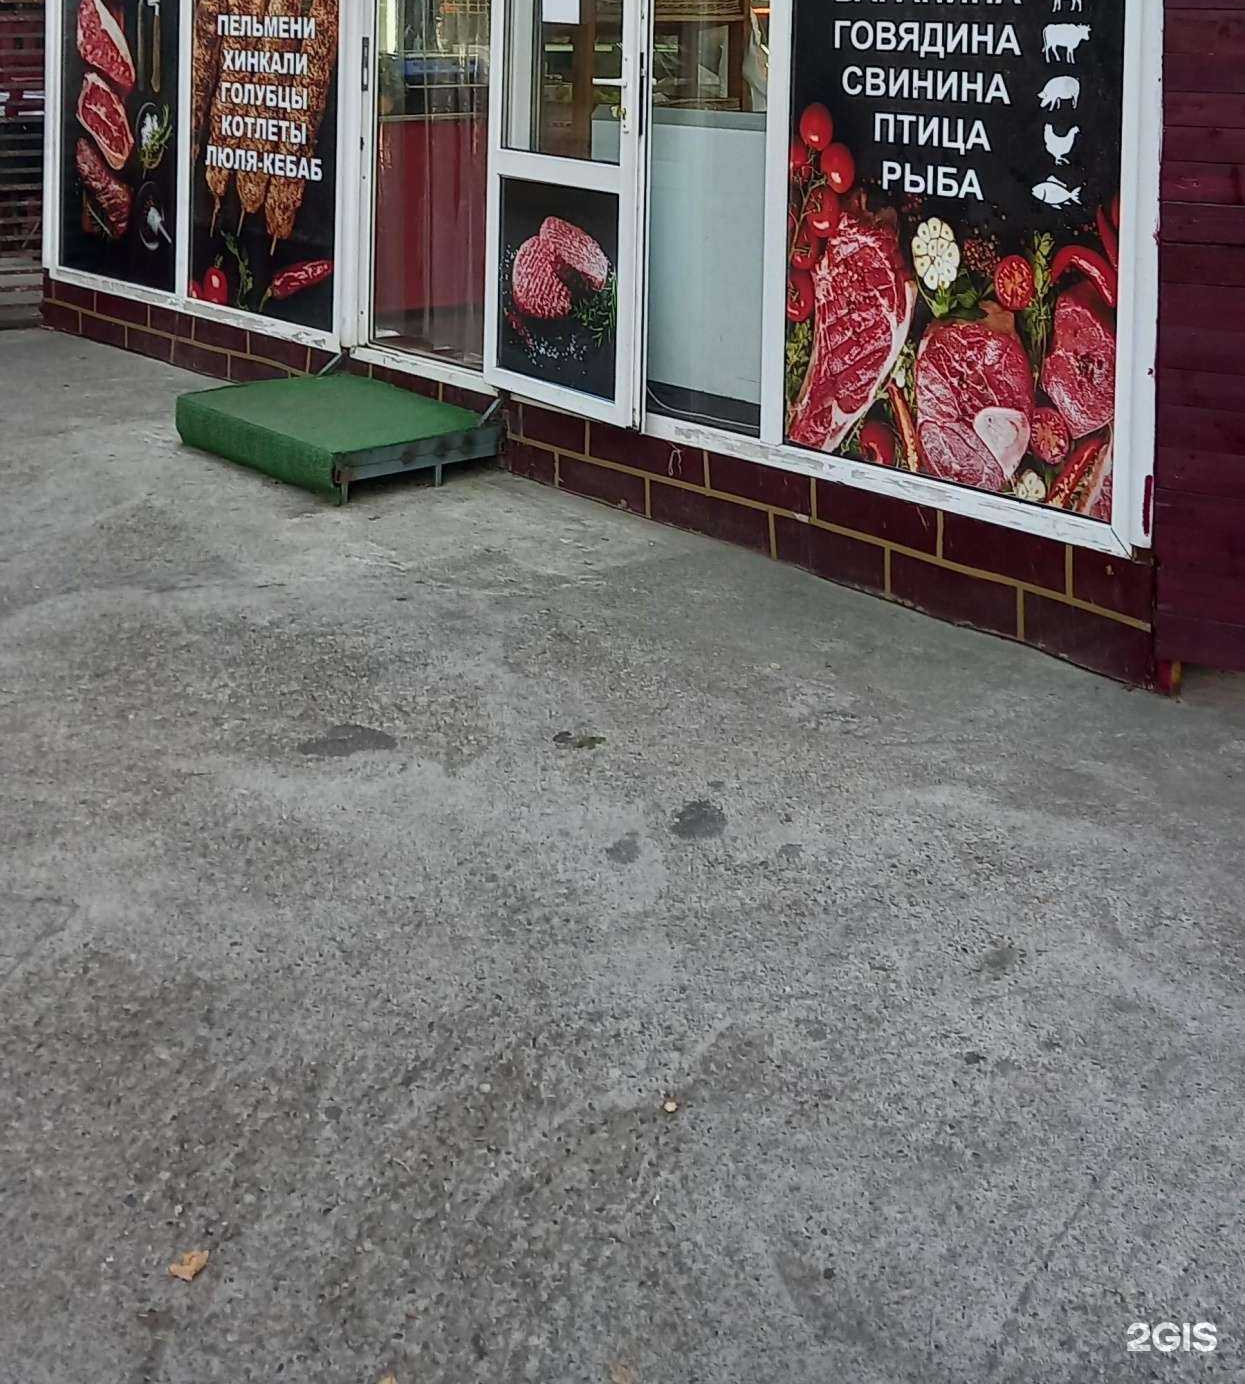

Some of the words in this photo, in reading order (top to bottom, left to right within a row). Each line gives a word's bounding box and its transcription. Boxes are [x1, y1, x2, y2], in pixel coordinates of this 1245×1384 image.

[217, 13, 316, 41] ПЕЛЬМЕНИ
[833, 20, 1022, 58] ГОВЯДИНА
[223, 49, 308, 76] ХИНКАЛИ
[220, 81, 308, 113] ГОЛУБЦЫ
[841, 65, 1011, 105] СВИНИНА
[221, 114, 307, 145] КОТЛЕТЫ
[874, 112, 992, 156] ПТИЦА
[205, 145, 323, 182] ЛЮЛЯ-КЕБАБ
[882, 161, 984, 201] РЫБА
